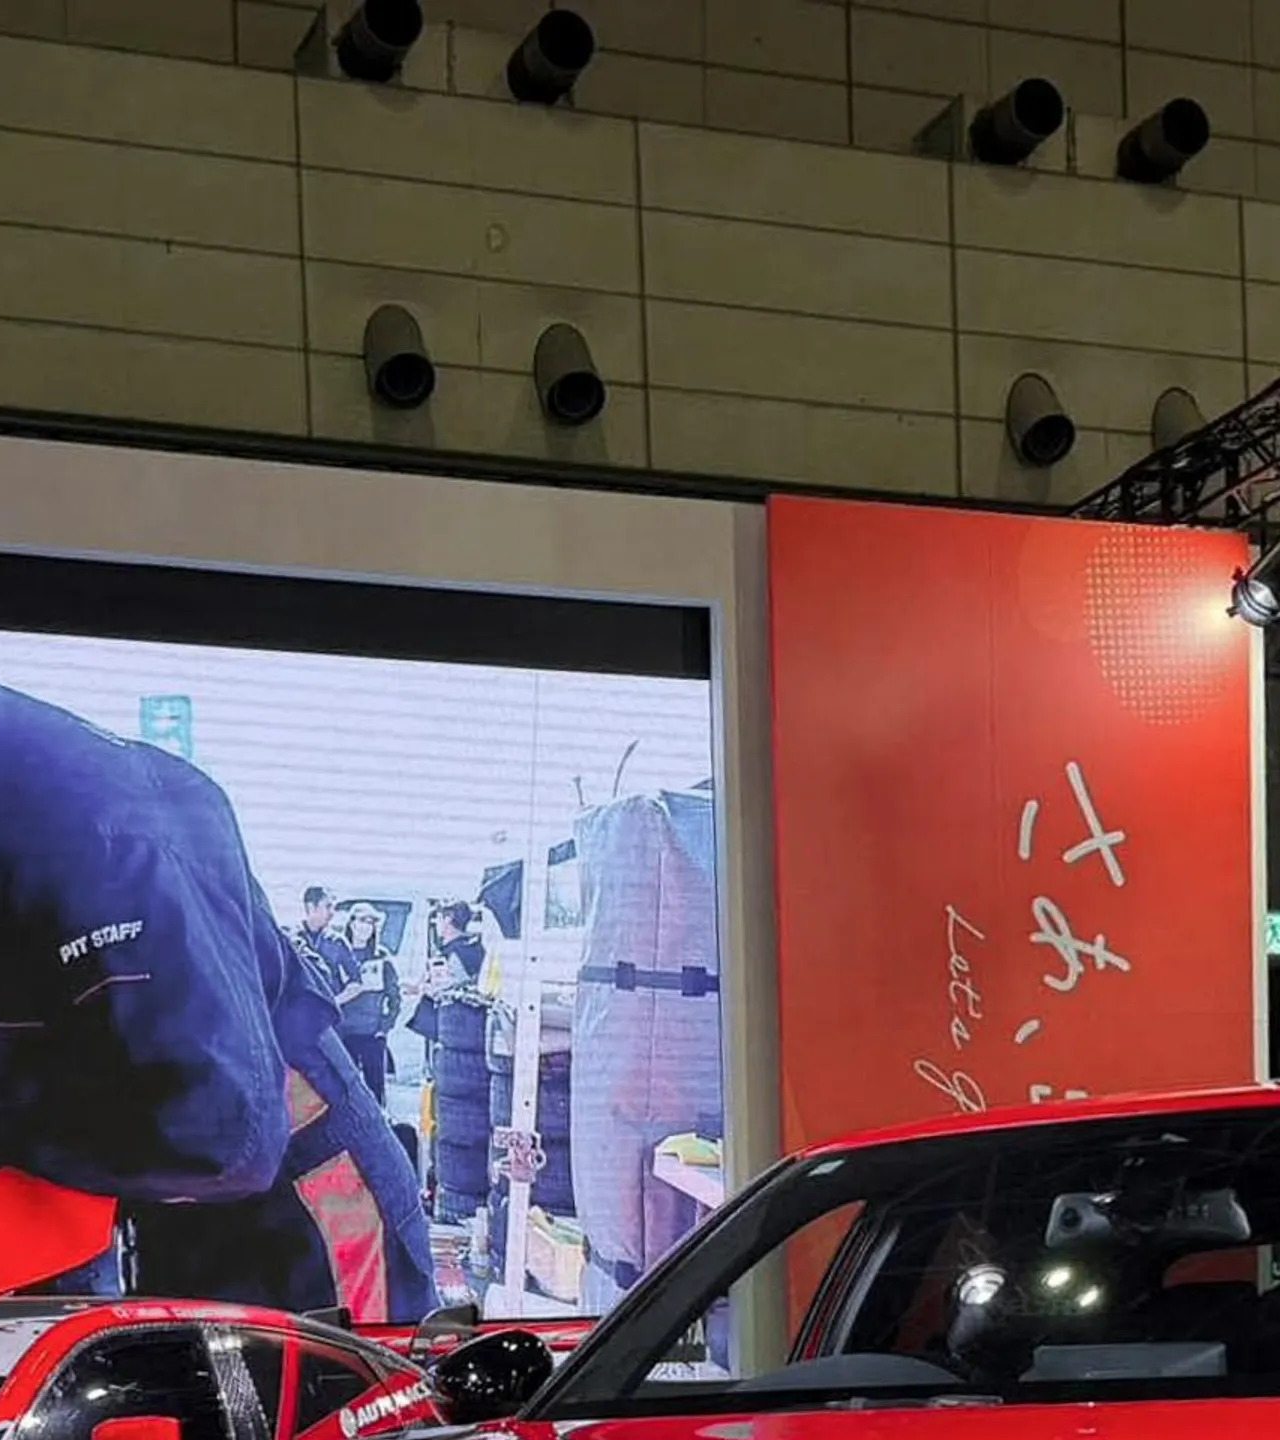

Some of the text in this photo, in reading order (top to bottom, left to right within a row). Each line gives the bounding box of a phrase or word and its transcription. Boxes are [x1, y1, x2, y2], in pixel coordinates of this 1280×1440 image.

[58, 919, 144, 964] PIT STAFF
[943, 904, 987, 1052] Let's
